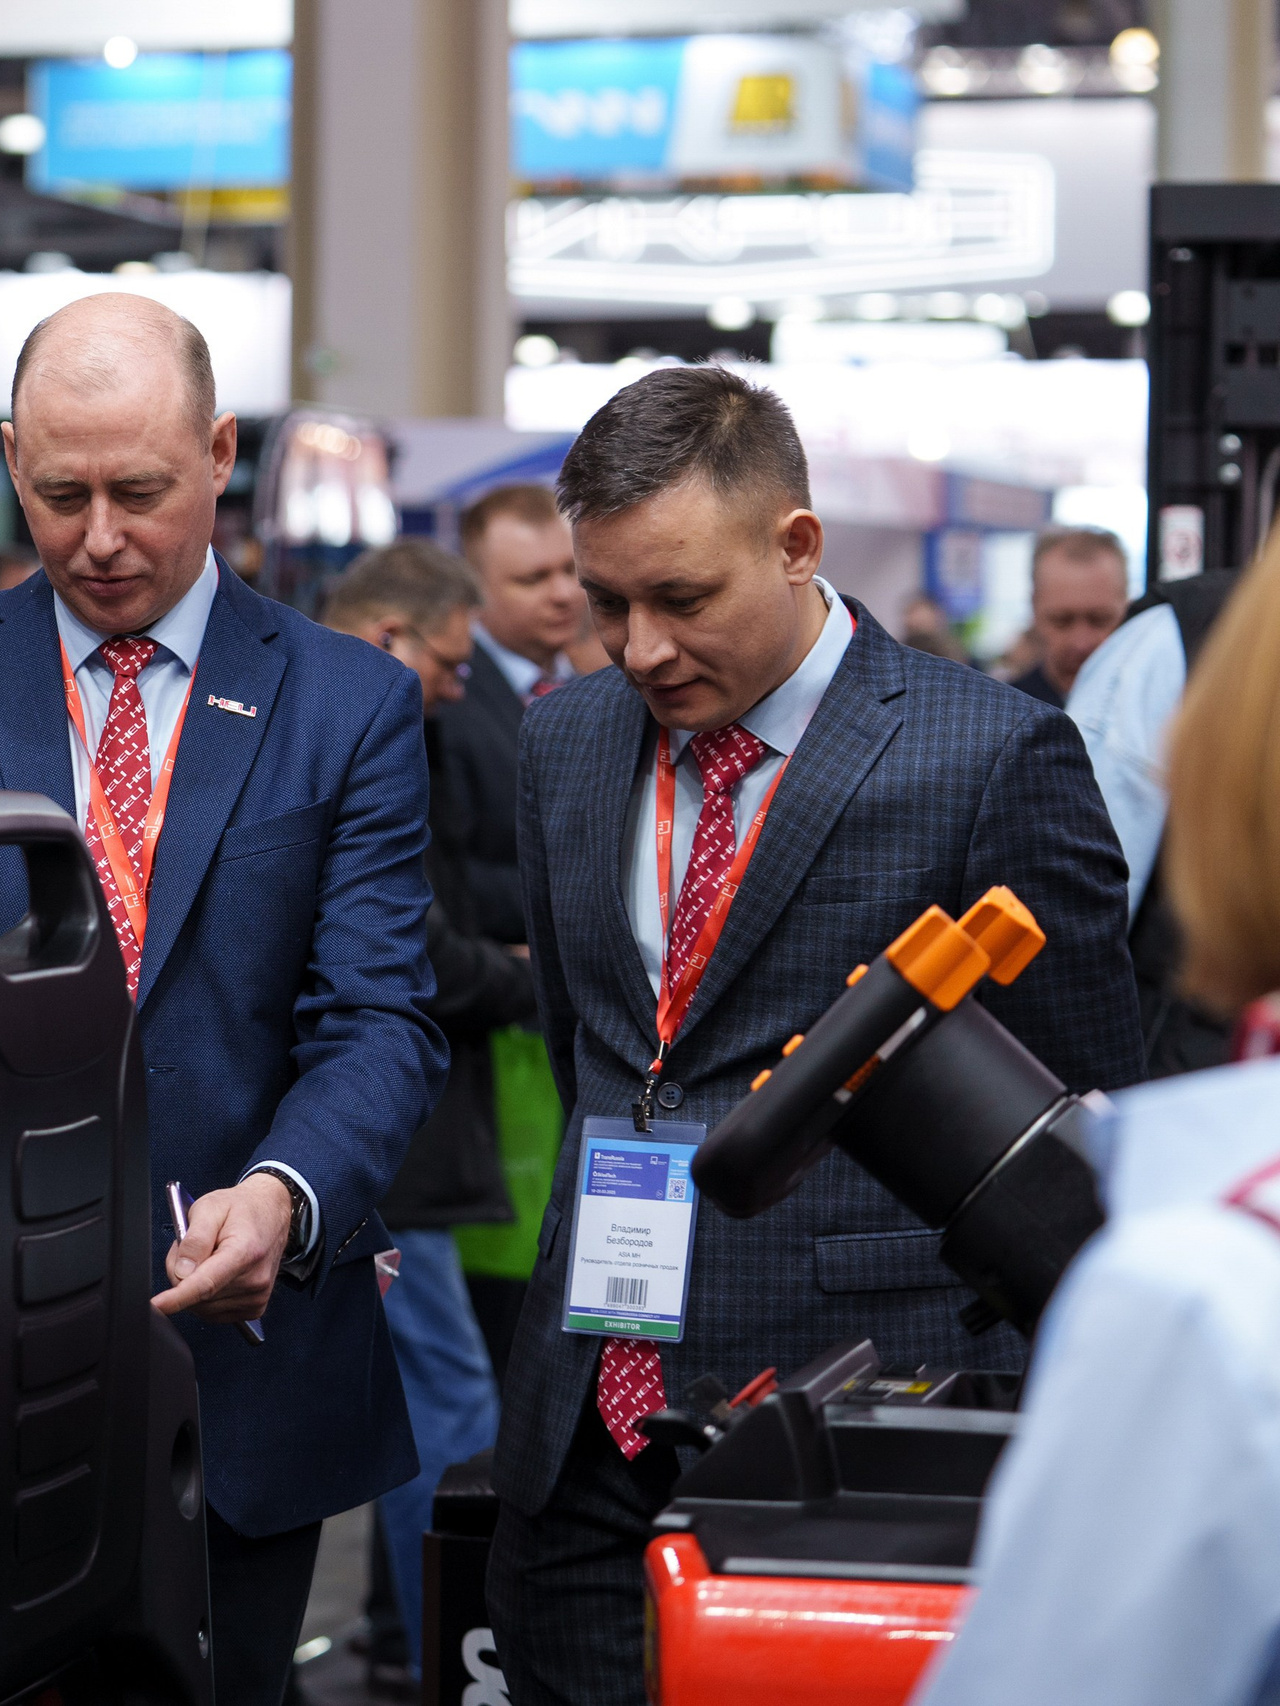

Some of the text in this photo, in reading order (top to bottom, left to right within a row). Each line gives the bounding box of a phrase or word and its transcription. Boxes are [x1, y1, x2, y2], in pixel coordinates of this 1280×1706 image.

[103, 646, 130, 671] HELI
[113, 678, 136, 700] HEL
[207, 694, 257, 718] HELI
[97, 726, 121, 759] HELI
[118, 717, 146, 745] HELI
[727, 725, 752, 757] HELI
[109, 742, 139, 773] HELI
[704, 743, 729, 772] HELI
[125, 766, 151, 790] HEL
[114, 786, 145, 819] HELI
[701, 811, 727, 840] HELI
[692, 839, 721, 869] HELI
[687, 867, 713, 899] HELI
[682, 897, 705, 929] HELI
[677, 926, 698, 958] HELI
[606, 1235, 654, 1248] Безбородов
[611, 1223, 652, 1236] Владимир
[604, 1320, 641, 1331] EXHIBITOR
[601, 1338, 619, 1360] HEL
[615, 1352, 642, 1383] HELI
[640, 1353, 660, 1375] HEL
[606, 1381, 632, 1411] HELI
[631, 1374, 659, 1404] HELI
[606, 1410, 624, 1431] ELI
[621, 1403, 649, 1434] HELI
[621, 1432, 640, 1453] ELI
